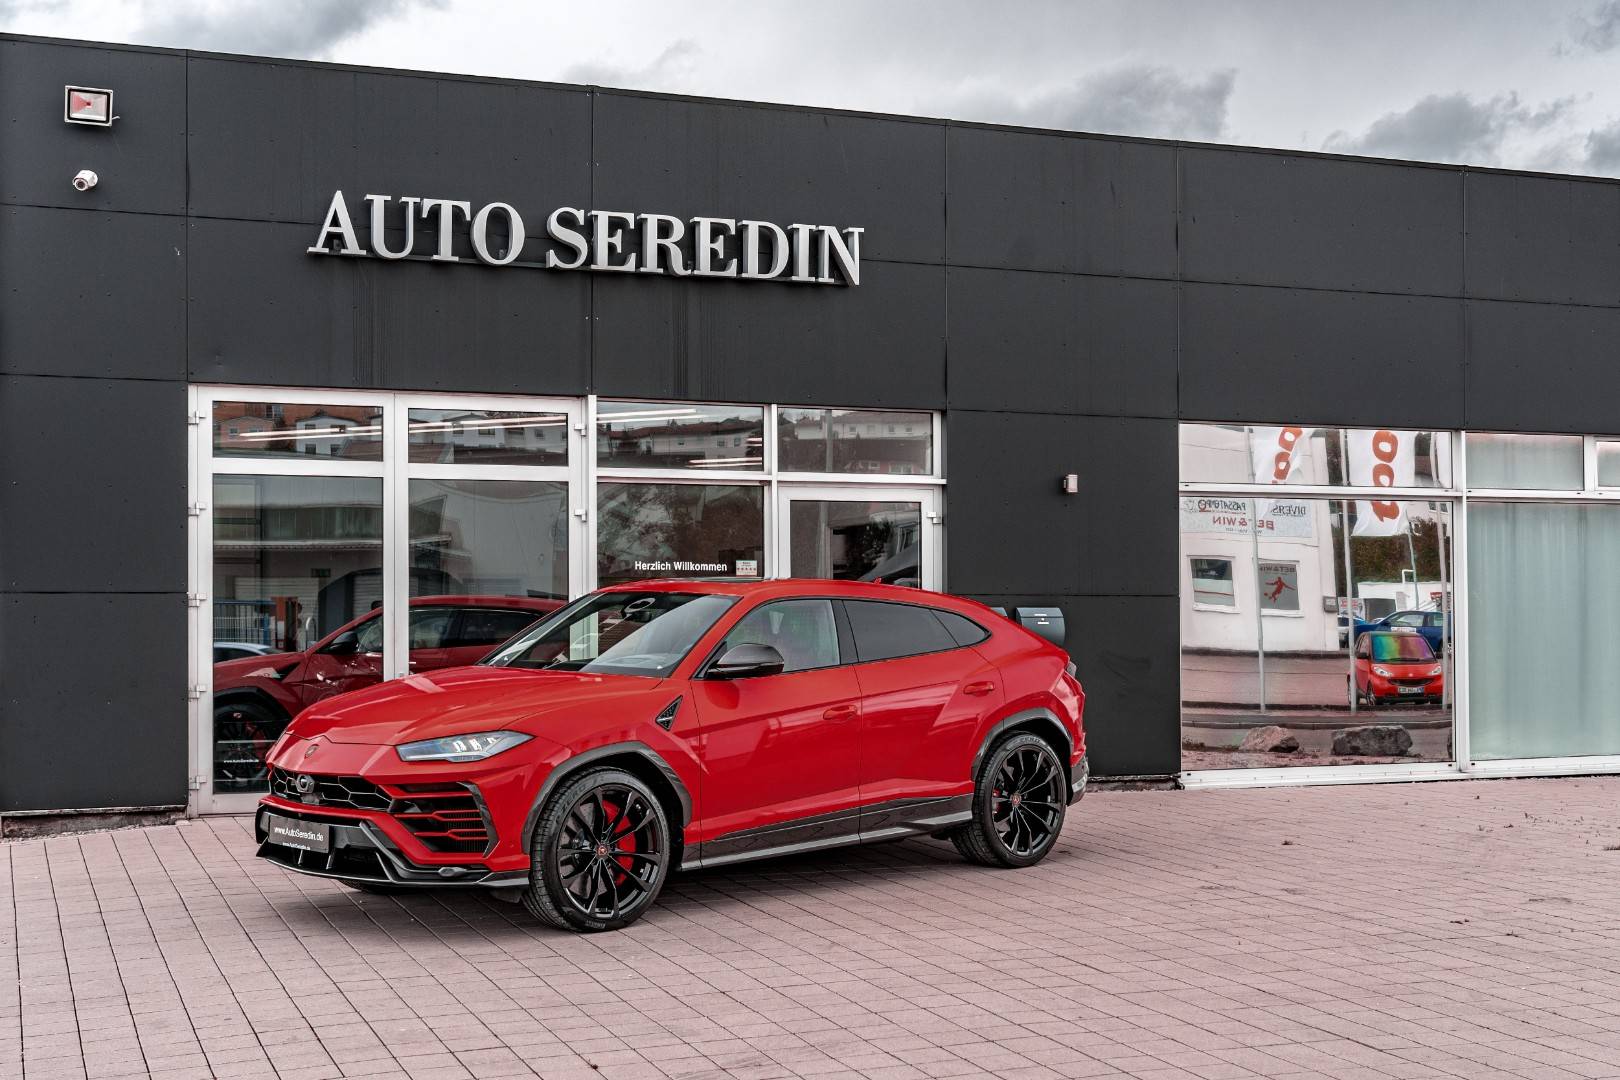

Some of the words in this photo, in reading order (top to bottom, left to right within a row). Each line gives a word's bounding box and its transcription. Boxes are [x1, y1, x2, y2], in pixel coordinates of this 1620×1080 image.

[307, 190, 525, 266] AUTO
[545, 206, 866, 287] SEREDIN
[634, 561, 671, 571] Herzlich
[673, 561, 728, 572] Willkommen
[274, 827, 324, 841] www.AutoSeredin.de
